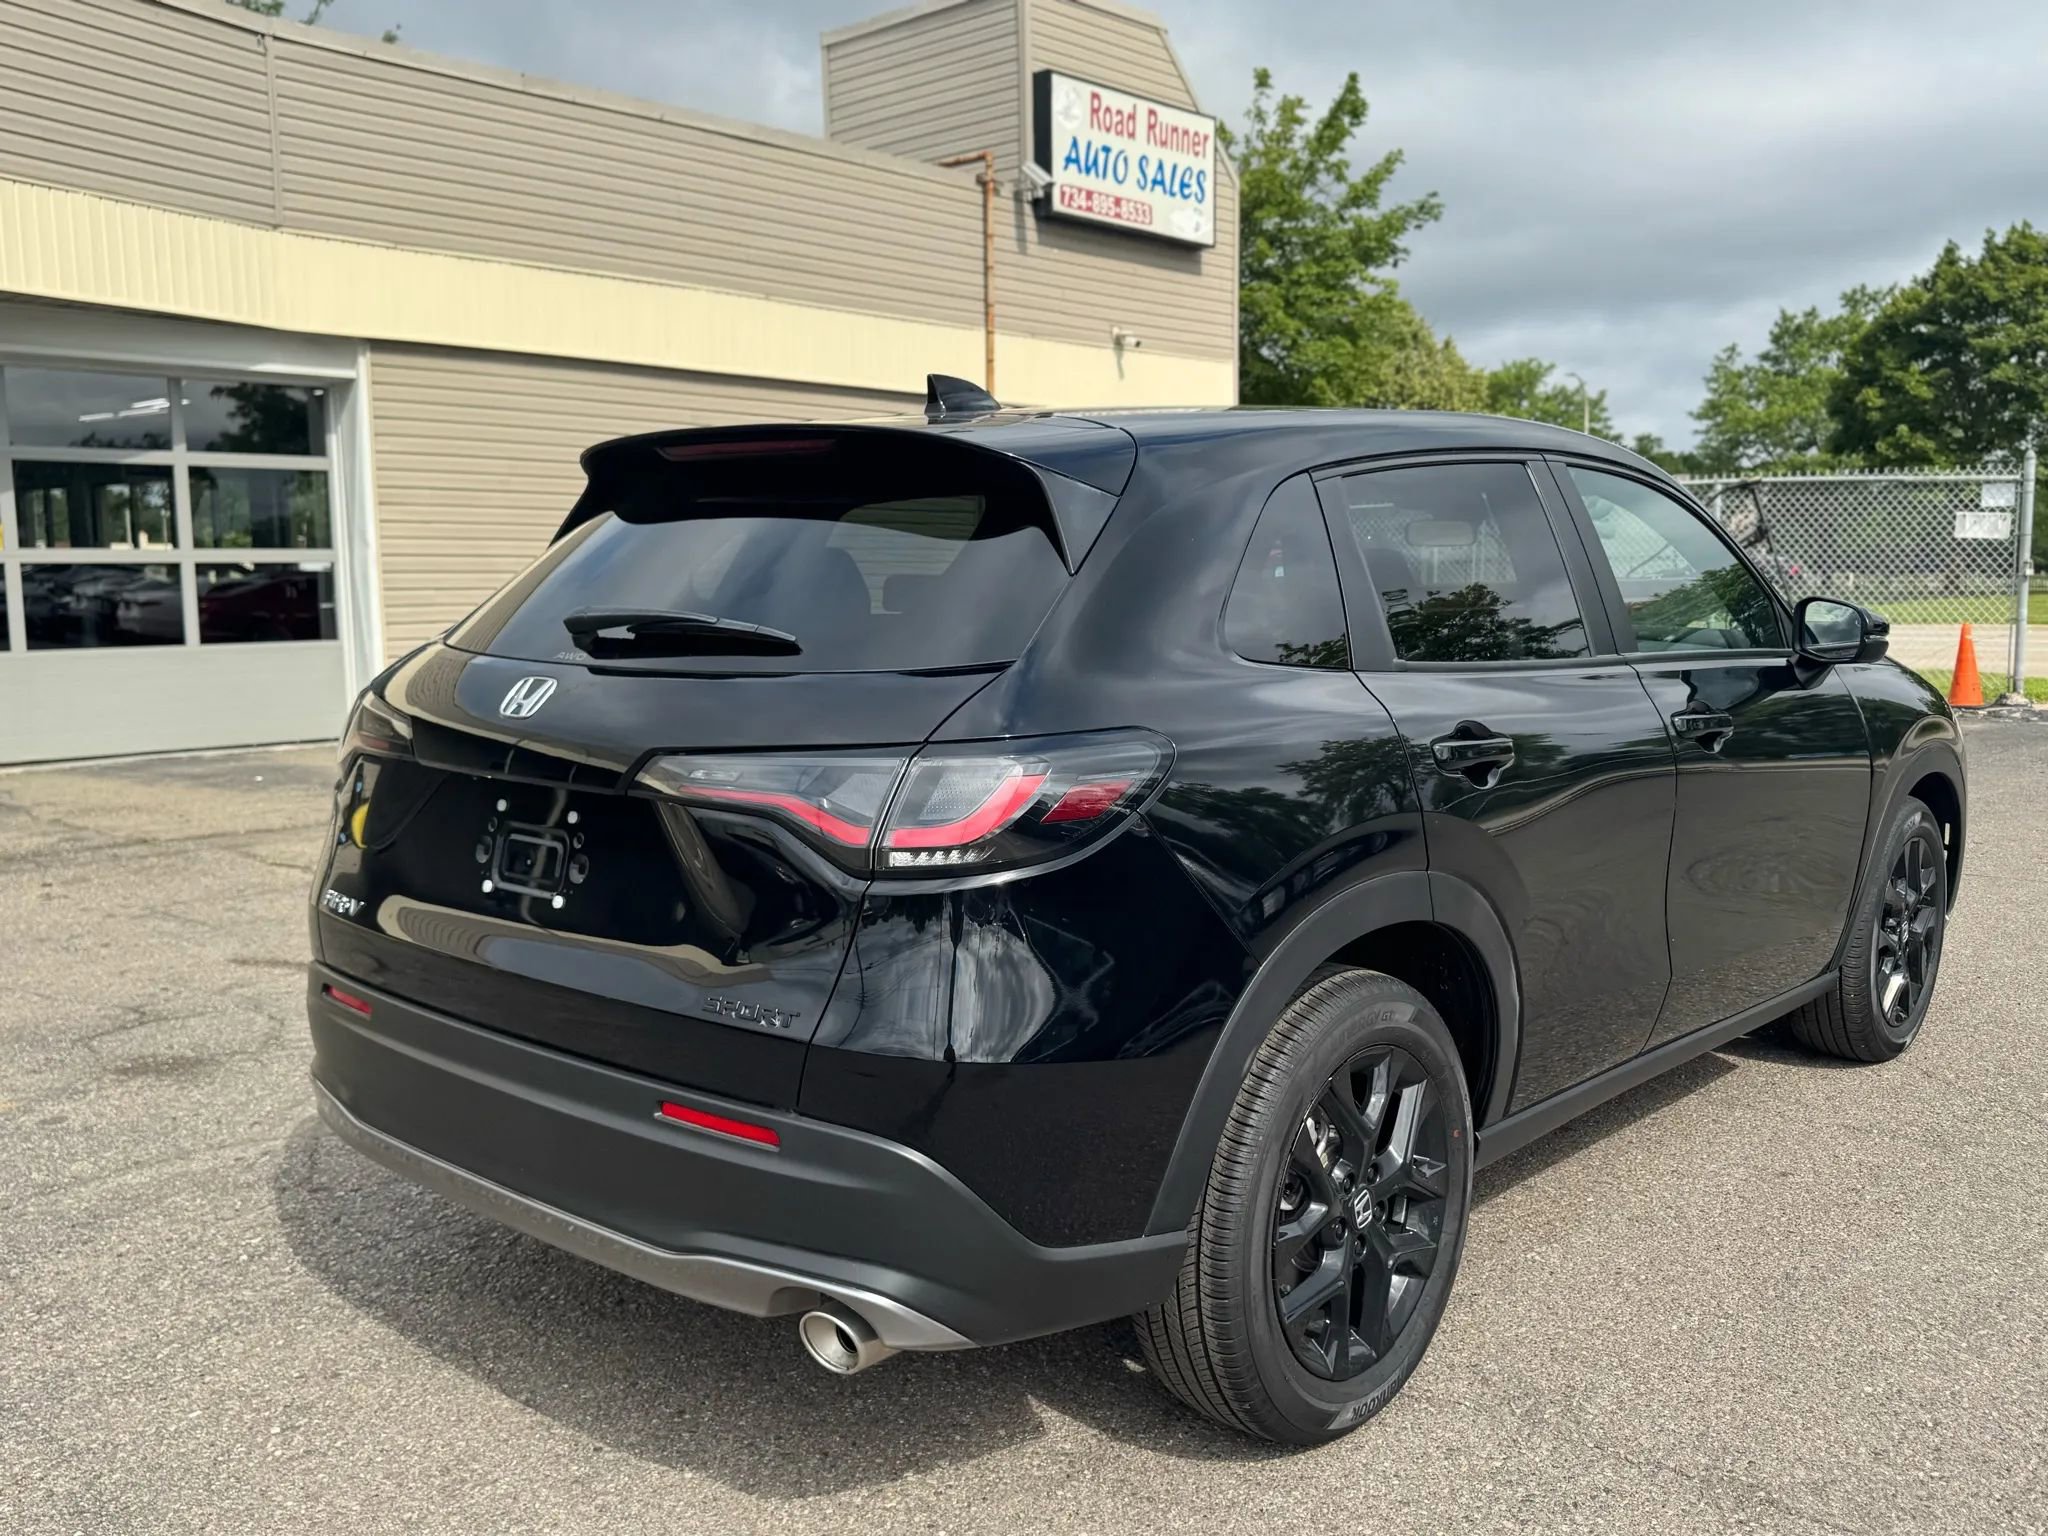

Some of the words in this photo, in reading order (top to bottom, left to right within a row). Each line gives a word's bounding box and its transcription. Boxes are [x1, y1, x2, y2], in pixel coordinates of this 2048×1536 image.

[1089, 91, 1137, 140] Road
[1147, 107, 1210, 159] Runner
[1063, 136, 1129, 185] AUTO
[1136, 155, 1207, 204] SALES
[702, 996, 801, 1029] SPORT
